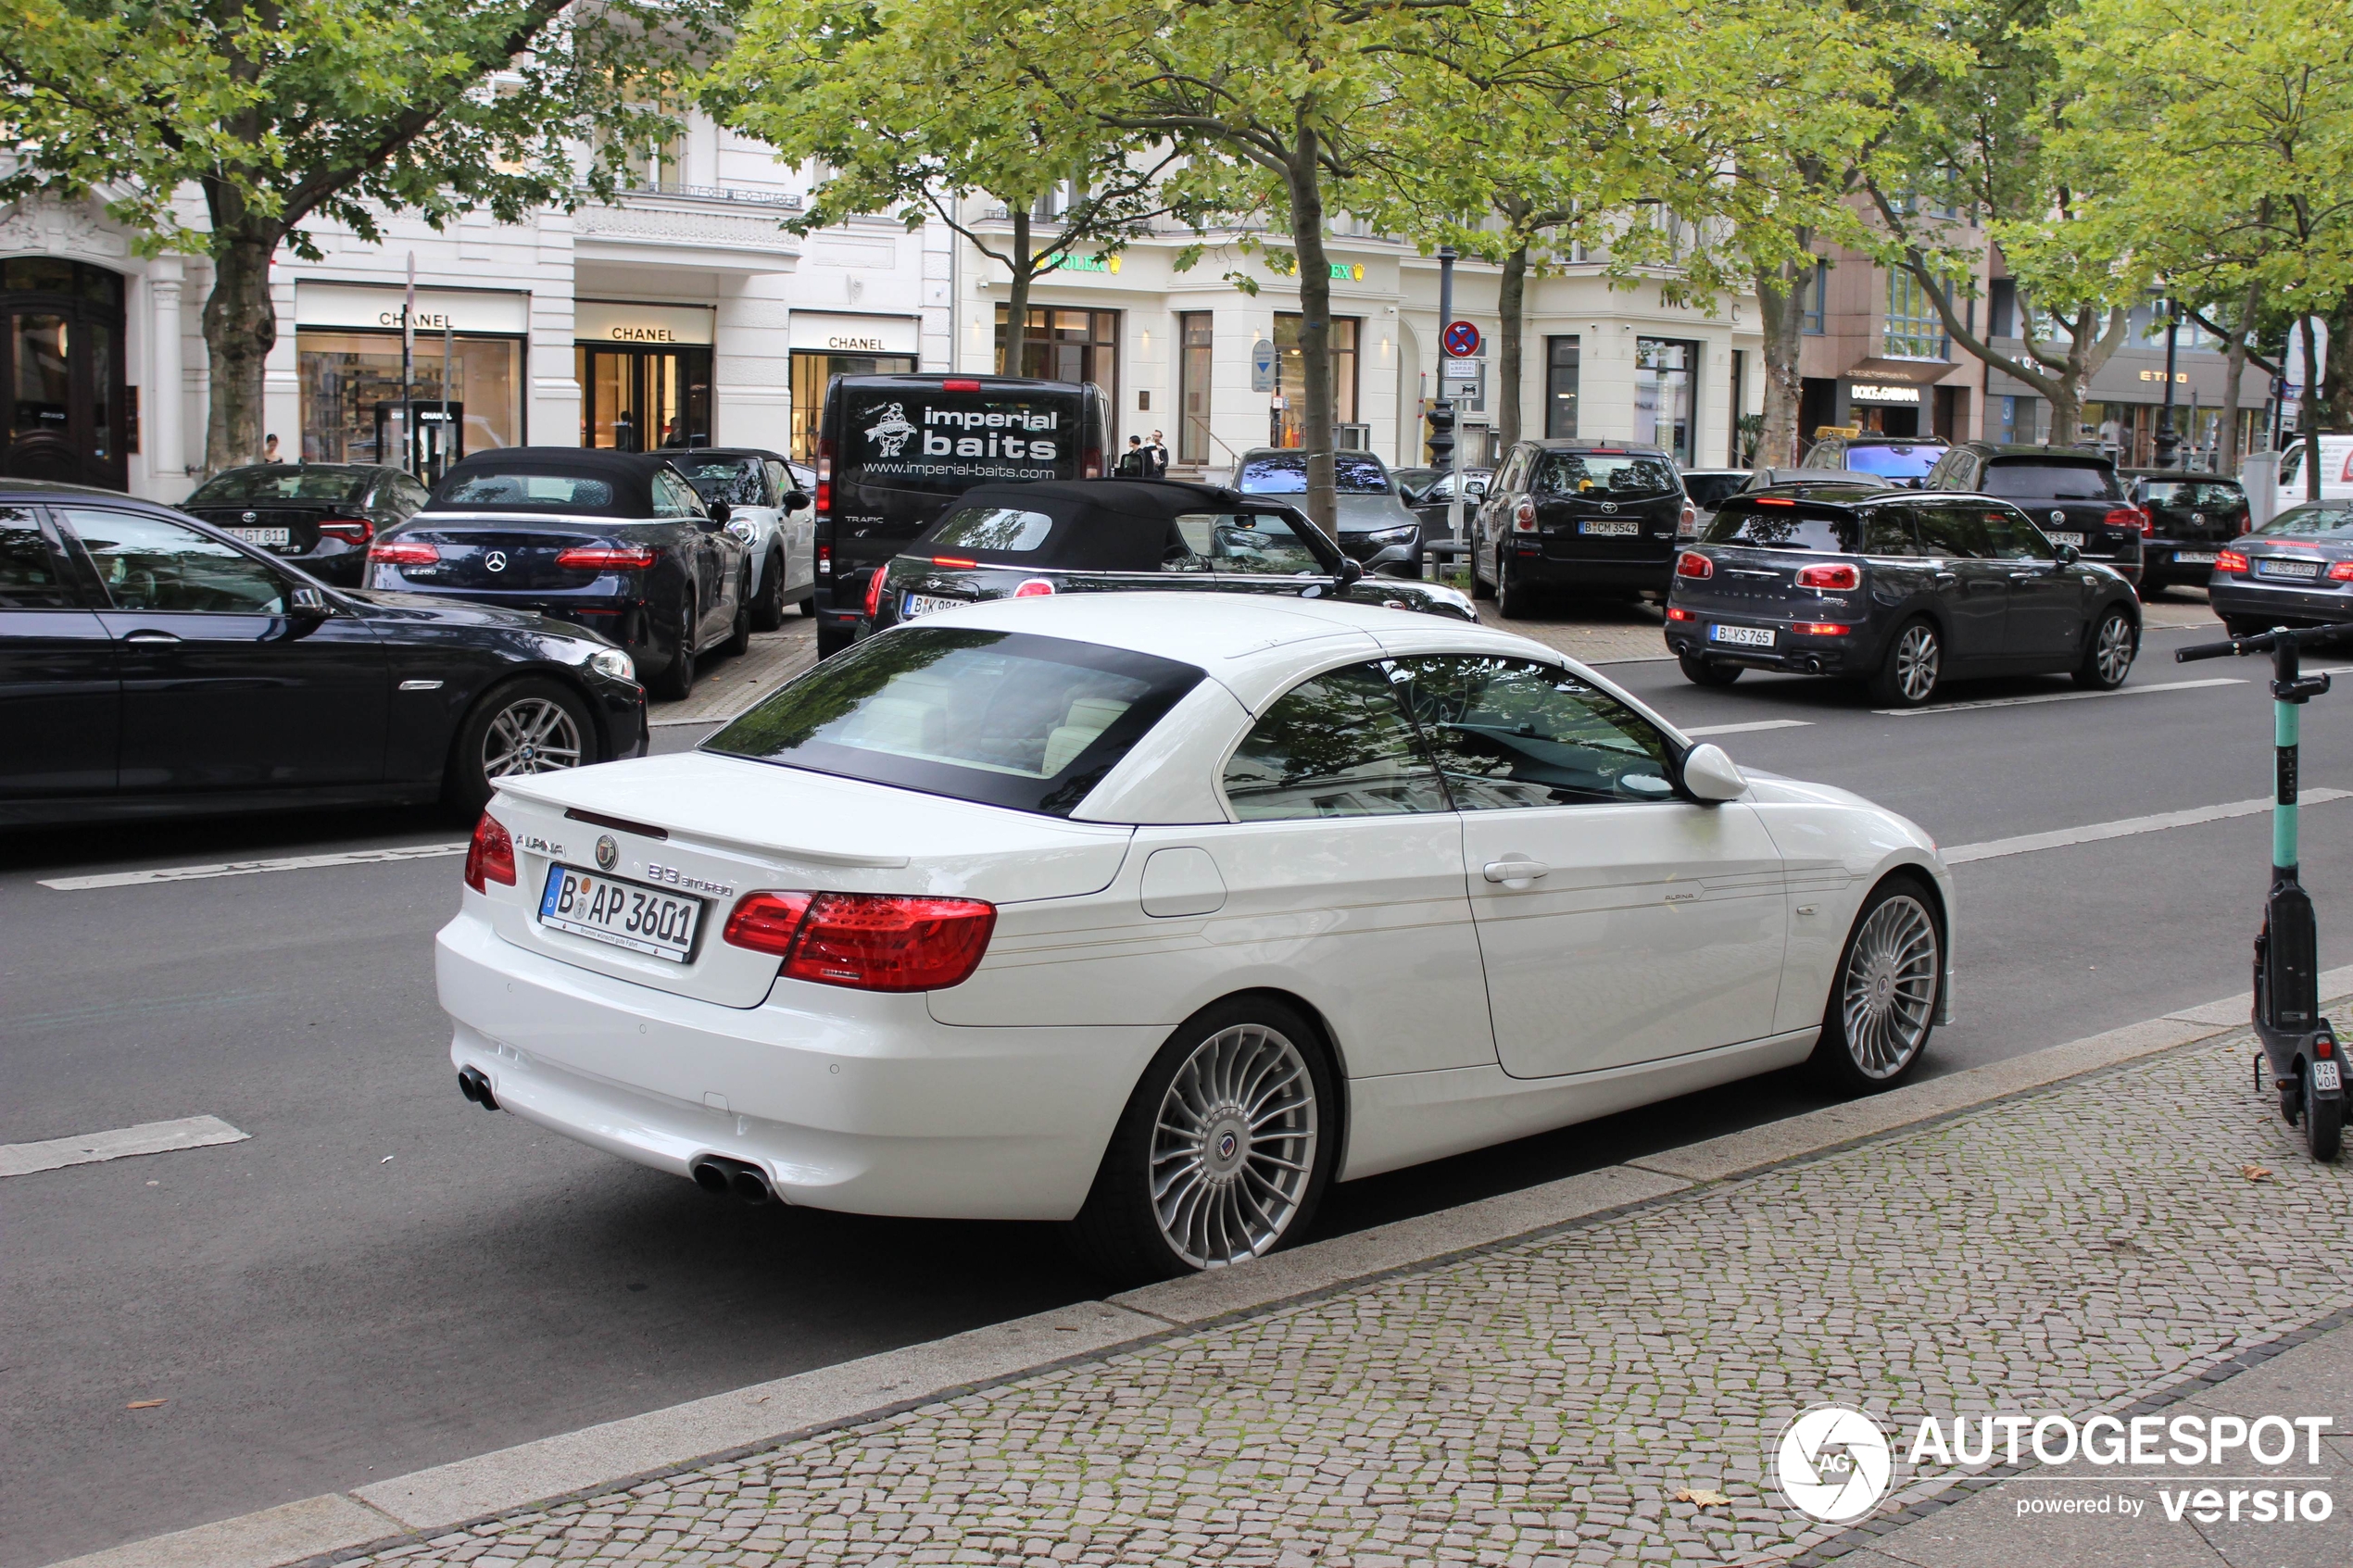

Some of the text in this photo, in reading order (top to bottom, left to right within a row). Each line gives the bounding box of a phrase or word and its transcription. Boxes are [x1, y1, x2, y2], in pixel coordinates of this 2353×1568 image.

[1050, 253, 1105, 272] ROLEX
[612, 328, 675, 342] CHANEL
[828, 336, 886, 351] CHANEL
[2139, 370, 2188, 383] ETO
[2003, 402, 2010, 420] 3
[925, 406, 1057, 431] imperial
[924, 430, 1057, 460] baits
[863, 461, 1055, 480] www.imperial-baits.com
[845, 516, 884, 524] TRAFIC
[1585, 522, 1637, 533] B CM 3542
[245, 530, 260, 542] GT
[264, 530, 286, 542] 811
[2049, 533, 2079, 543] FS 492
[2266, 562, 2272, 571] B
[2292, 564, 2316, 575] 1002
[1715, 590, 1786, 600] CLUBMAN
[914, 597, 923, 612] B
[927, 598, 937, 613] K
[1719, 627, 1727, 639] B
[1750, 630, 1770, 644] 765
[515, 834, 567, 857] ALPINA
[648, 862, 734, 897] B3 BITURBO
[547, 897, 554, 908] D
[558, 875, 692, 946] B AP 3601
[615, 936, 625, 945] gute
[626, 939, 638, 948] Fahrt
[2316, 1064, 2335, 1075] 926
[2318, 1075, 2338, 1088] WOA
